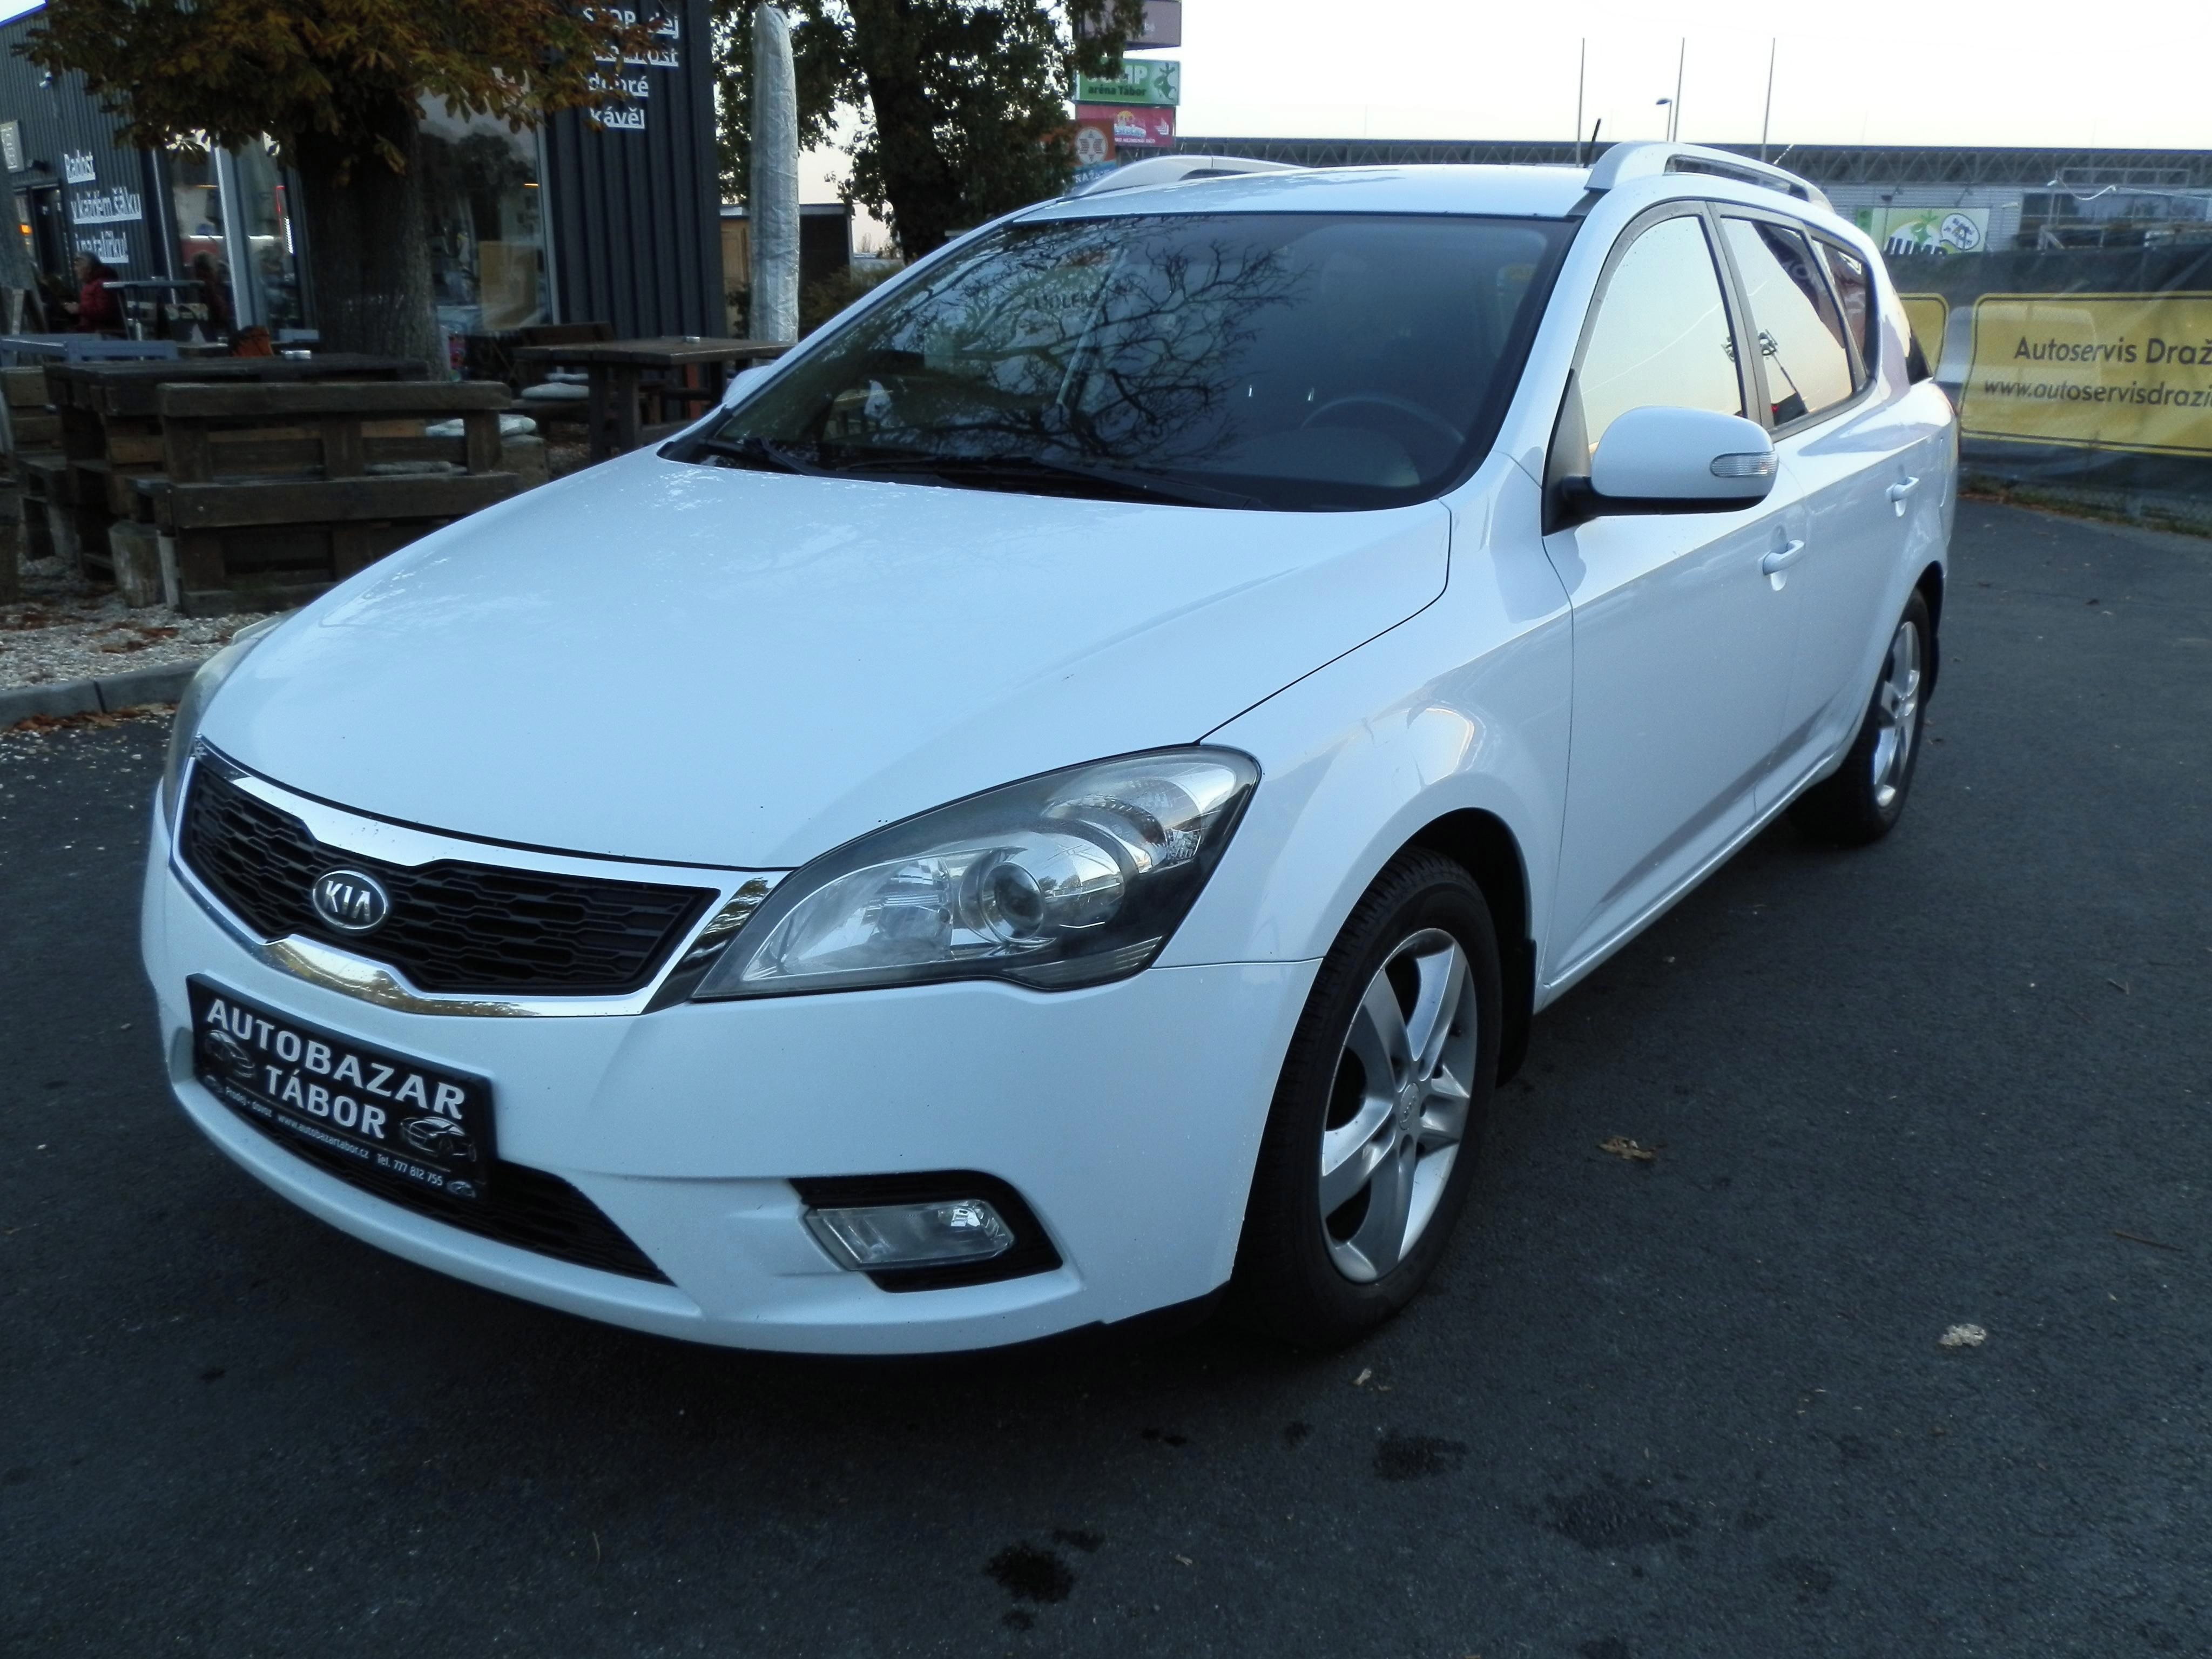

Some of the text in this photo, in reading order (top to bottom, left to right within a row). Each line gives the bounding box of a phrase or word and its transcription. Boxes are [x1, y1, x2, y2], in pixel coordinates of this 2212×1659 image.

[583, 8, 636, 29] SOP
[1088, 84, 1147, 96] aréna Tábor
[2014, 336, 2212, 366] Autoservis Draž
[1984, 380, 2212, 407] www.autoservisdrazi
[325, 880, 372, 922] KIA
[207, 999, 465, 1120] AUTOBAZAR
[266, 1064, 386, 1139] TÁBOR
[277, 1114, 370, 1159] www.autobazartabor.cz
[377, 1154, 391, 1167] Tel.
[394, 1159, 408, 1173] 777
[410, 1166, 424, 1180] 812
[427, 1172, 443, 1186] 755
